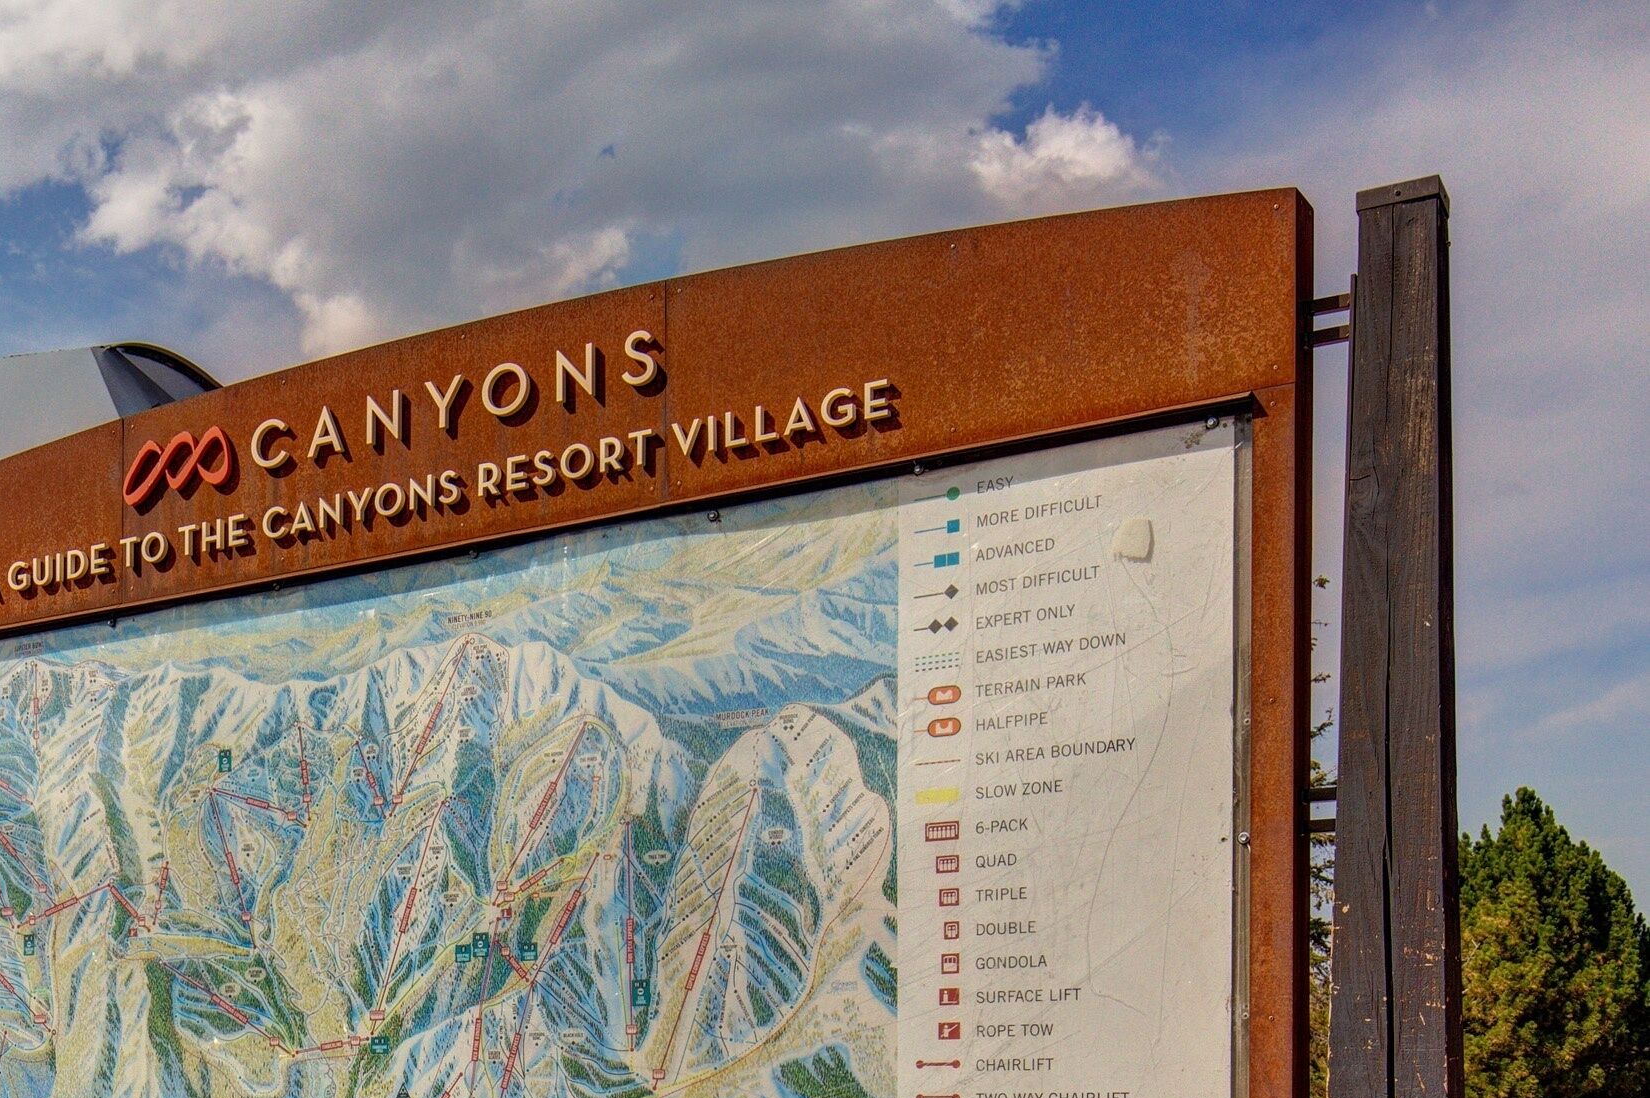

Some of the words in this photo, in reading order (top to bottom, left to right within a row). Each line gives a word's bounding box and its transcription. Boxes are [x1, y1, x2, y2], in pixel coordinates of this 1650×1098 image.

[251, 330, 657, 469] CANYONS
[7, 543, 110, 592] GUIDE
[119, 532, 169, 568] TO
[178, 513, 249, 557] THE
[262, 469, 462, 540] CANYONS
[478, 429, 654, 498] RESORT
[671, 378, 891, 457] VILLAGE
[977, 477, 1013, 493] EASY
[977, 509, 1019, 527] MORE
[1025, 495, 1102, 519] DIFFICULT
[976, 538, 1055, 561] ADVANCED
[976, 578, 1017, 595] MOST
[1023, 566, 1100, 588] DIFFICULT
[976, 610, 1031, 629] EXPERT
[1037, 604, 1075, 621] ONLY
[977, 644, 1040, 663] EASIEST
[1043, 640, 1073, 654] WAY
[1080, 633, 1125, 650] DOWN
[975, 679, 1040, 696] TERRAIN
[1047, 673, 1086, 689] PARK
[716, 711, 750, 721] MURDOCK
[751, 709, 769, 717] PEAK
[976, 712, 1047, 730] HALFPIPE
[976, 752, 999, 765] SKI
[1005, 747, 1045, 762] AREA
[1051, 738, 1135, 758] BOUNDARY
[976, 784, 1017, 799] SLOW
[1022, 780, 1062, 795] ZONE
[976, 818, 1028, 834] 6-PACK
[976, 854, 1017, 868] QUAD
[976, 887, 1027, 901] TRIPLE
[976, 921, 1036, 936] DOUBLE
[976, 955, 1047, 970] GONDOLA
[977, 989, 1043, 1003] SURFACE
[1050, 988, 1081, 1001] LIFT
[975, 1025, 1015, 1037] ROPE
[1021, 1024, 1053, 1036] TOW
[976, 1058, 1054, 1071] CHAIRLIFT
